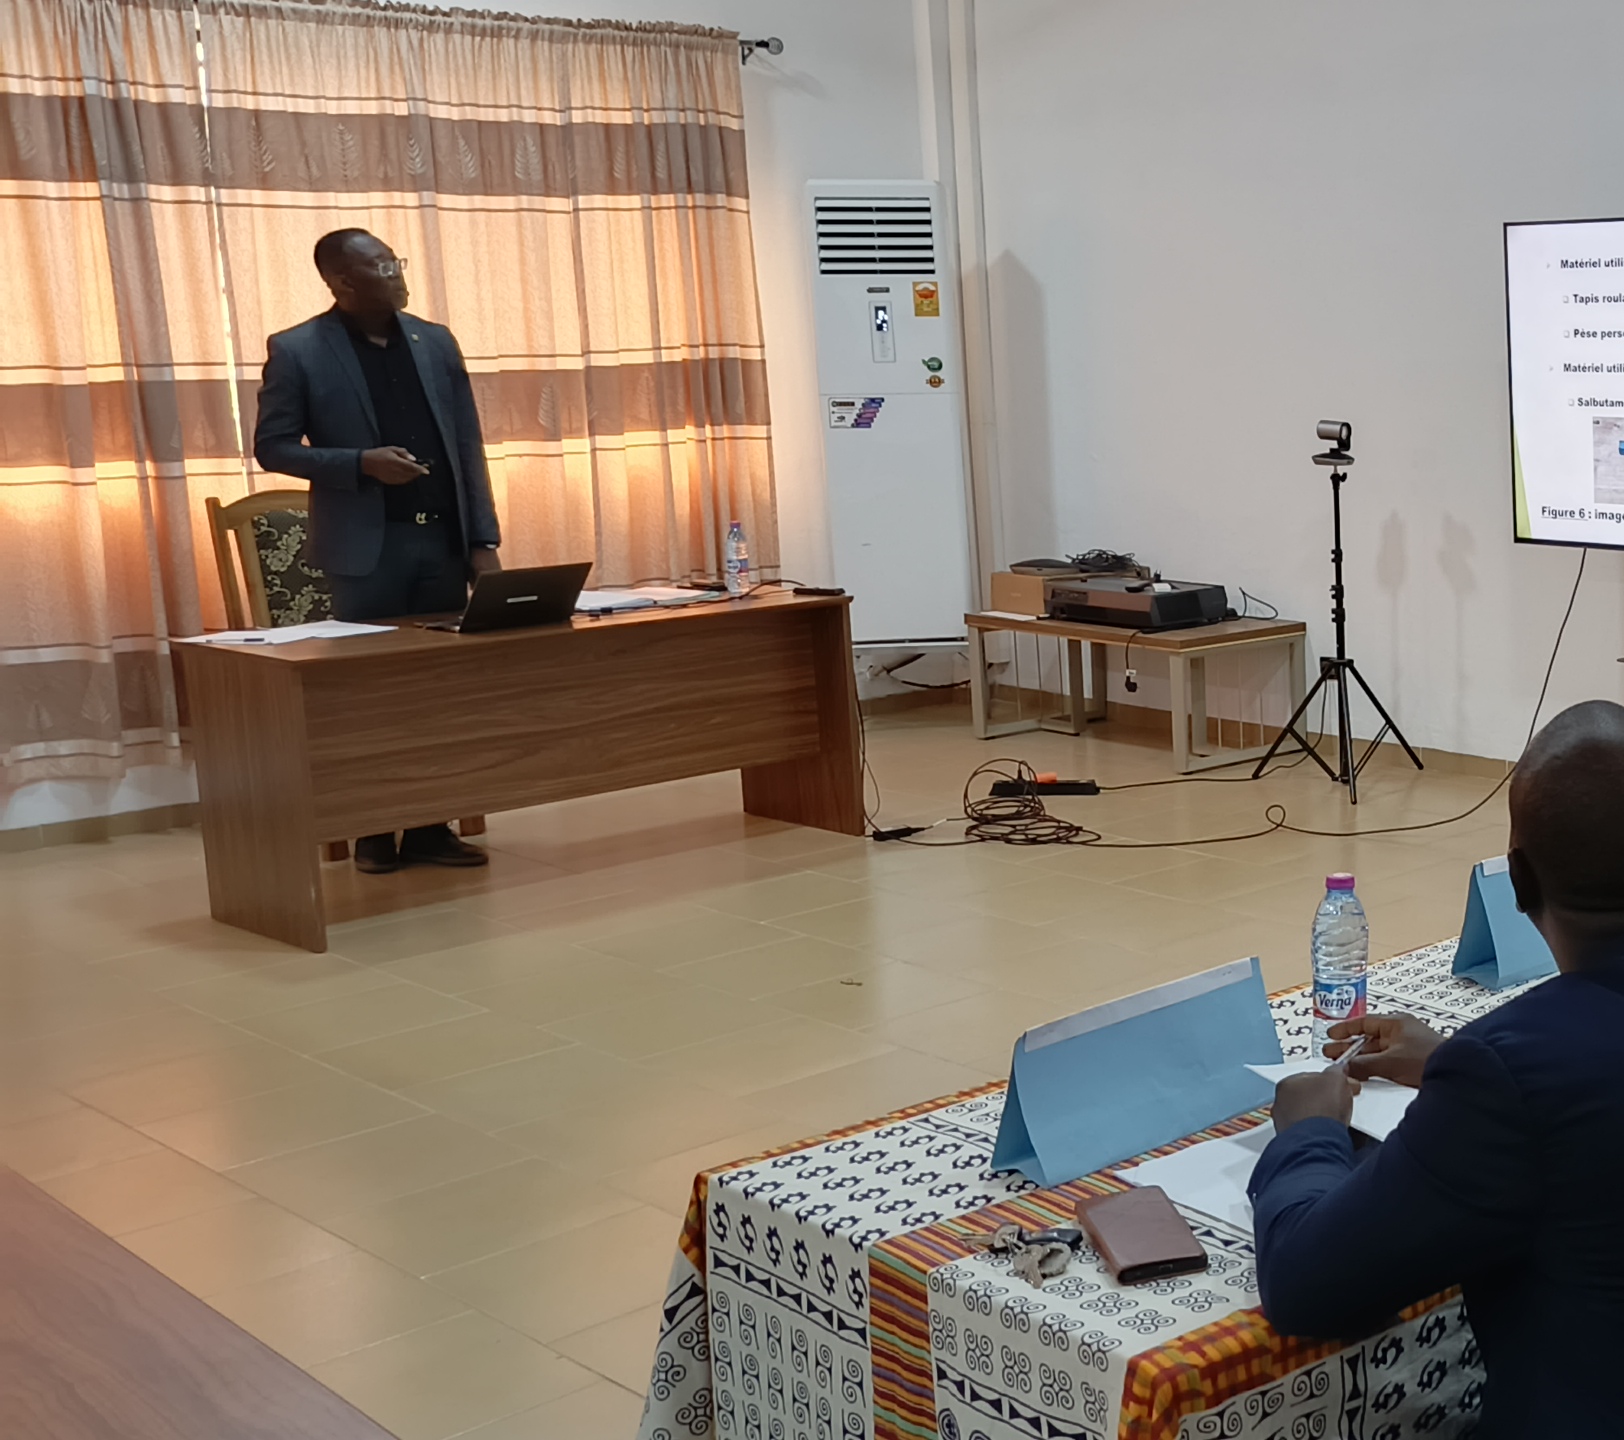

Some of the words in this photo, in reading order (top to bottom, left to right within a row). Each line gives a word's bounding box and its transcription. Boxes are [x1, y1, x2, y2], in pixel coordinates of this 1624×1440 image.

[1560, 257, 1602, 269] Matériel
[1572, 292, 1600, 306] Tapis
[1563, 362, 1604, 374] Matériel
[1541, 506, 1577, 519] Figure
[1577, 508, 1587, 520] 6
[1318, 993, 1352, 1010] Verna
